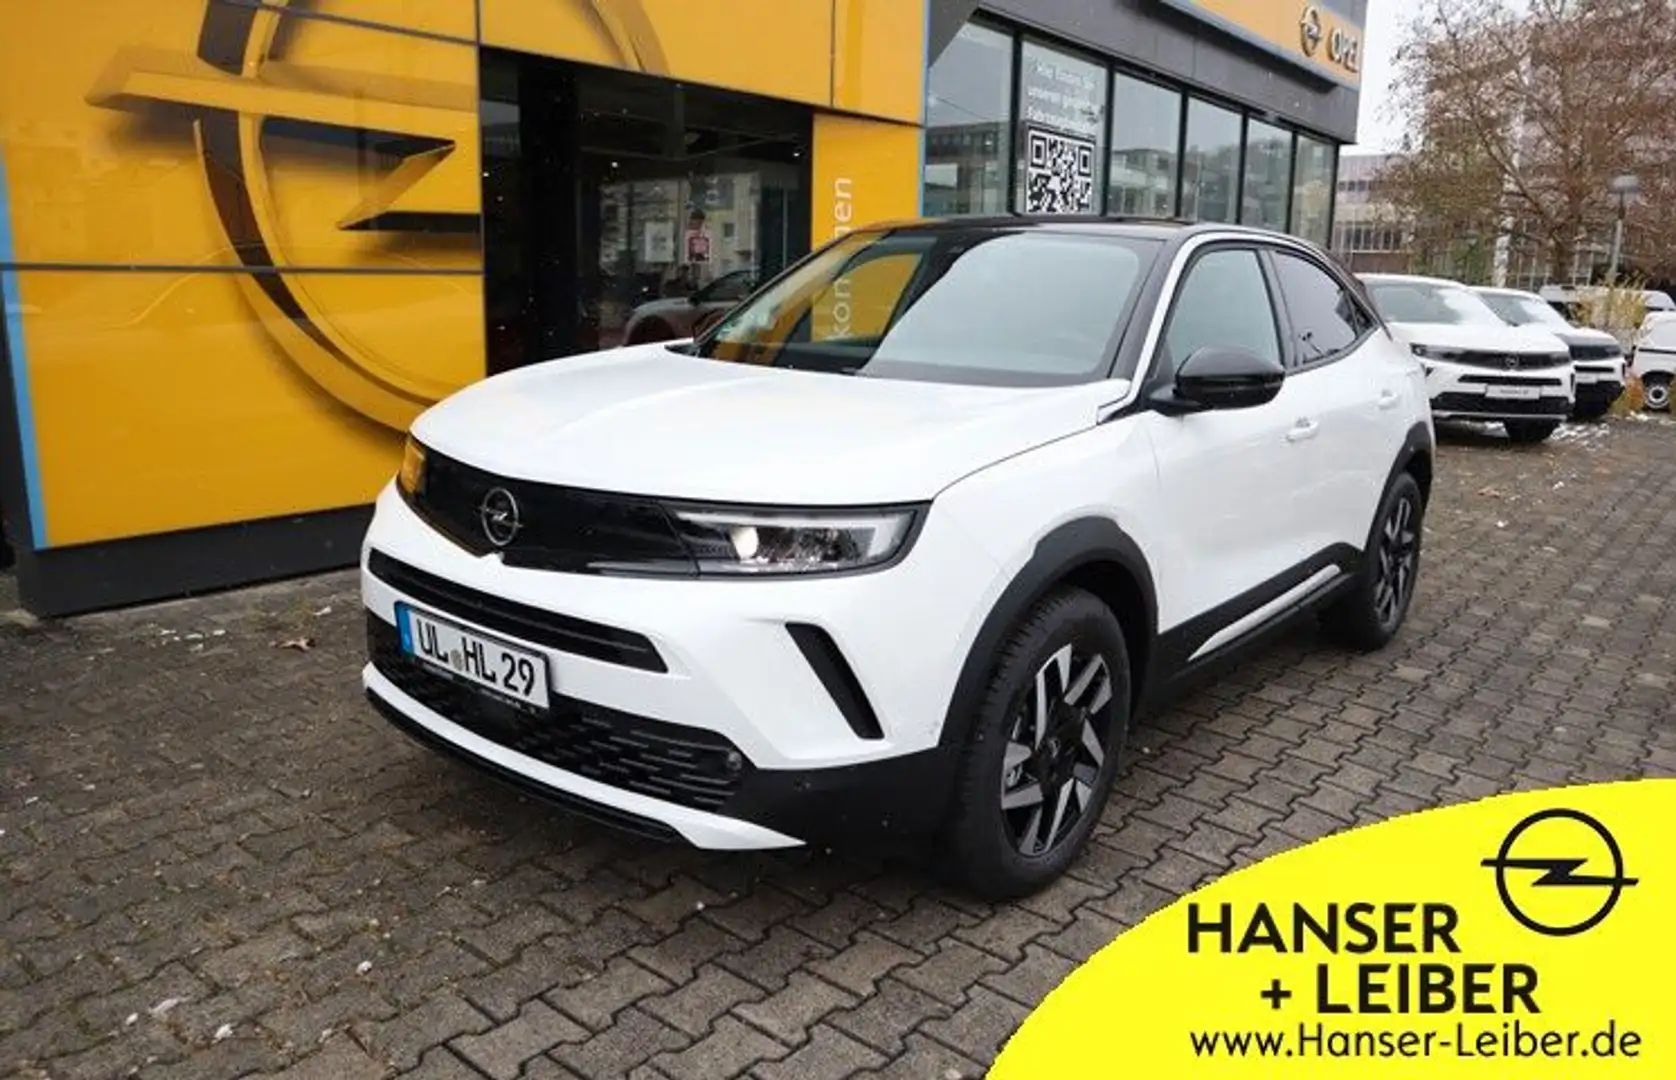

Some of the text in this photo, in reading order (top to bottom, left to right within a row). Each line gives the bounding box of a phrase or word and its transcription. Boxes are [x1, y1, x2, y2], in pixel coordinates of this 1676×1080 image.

[416, 617, 535, 696] UL HL 29
